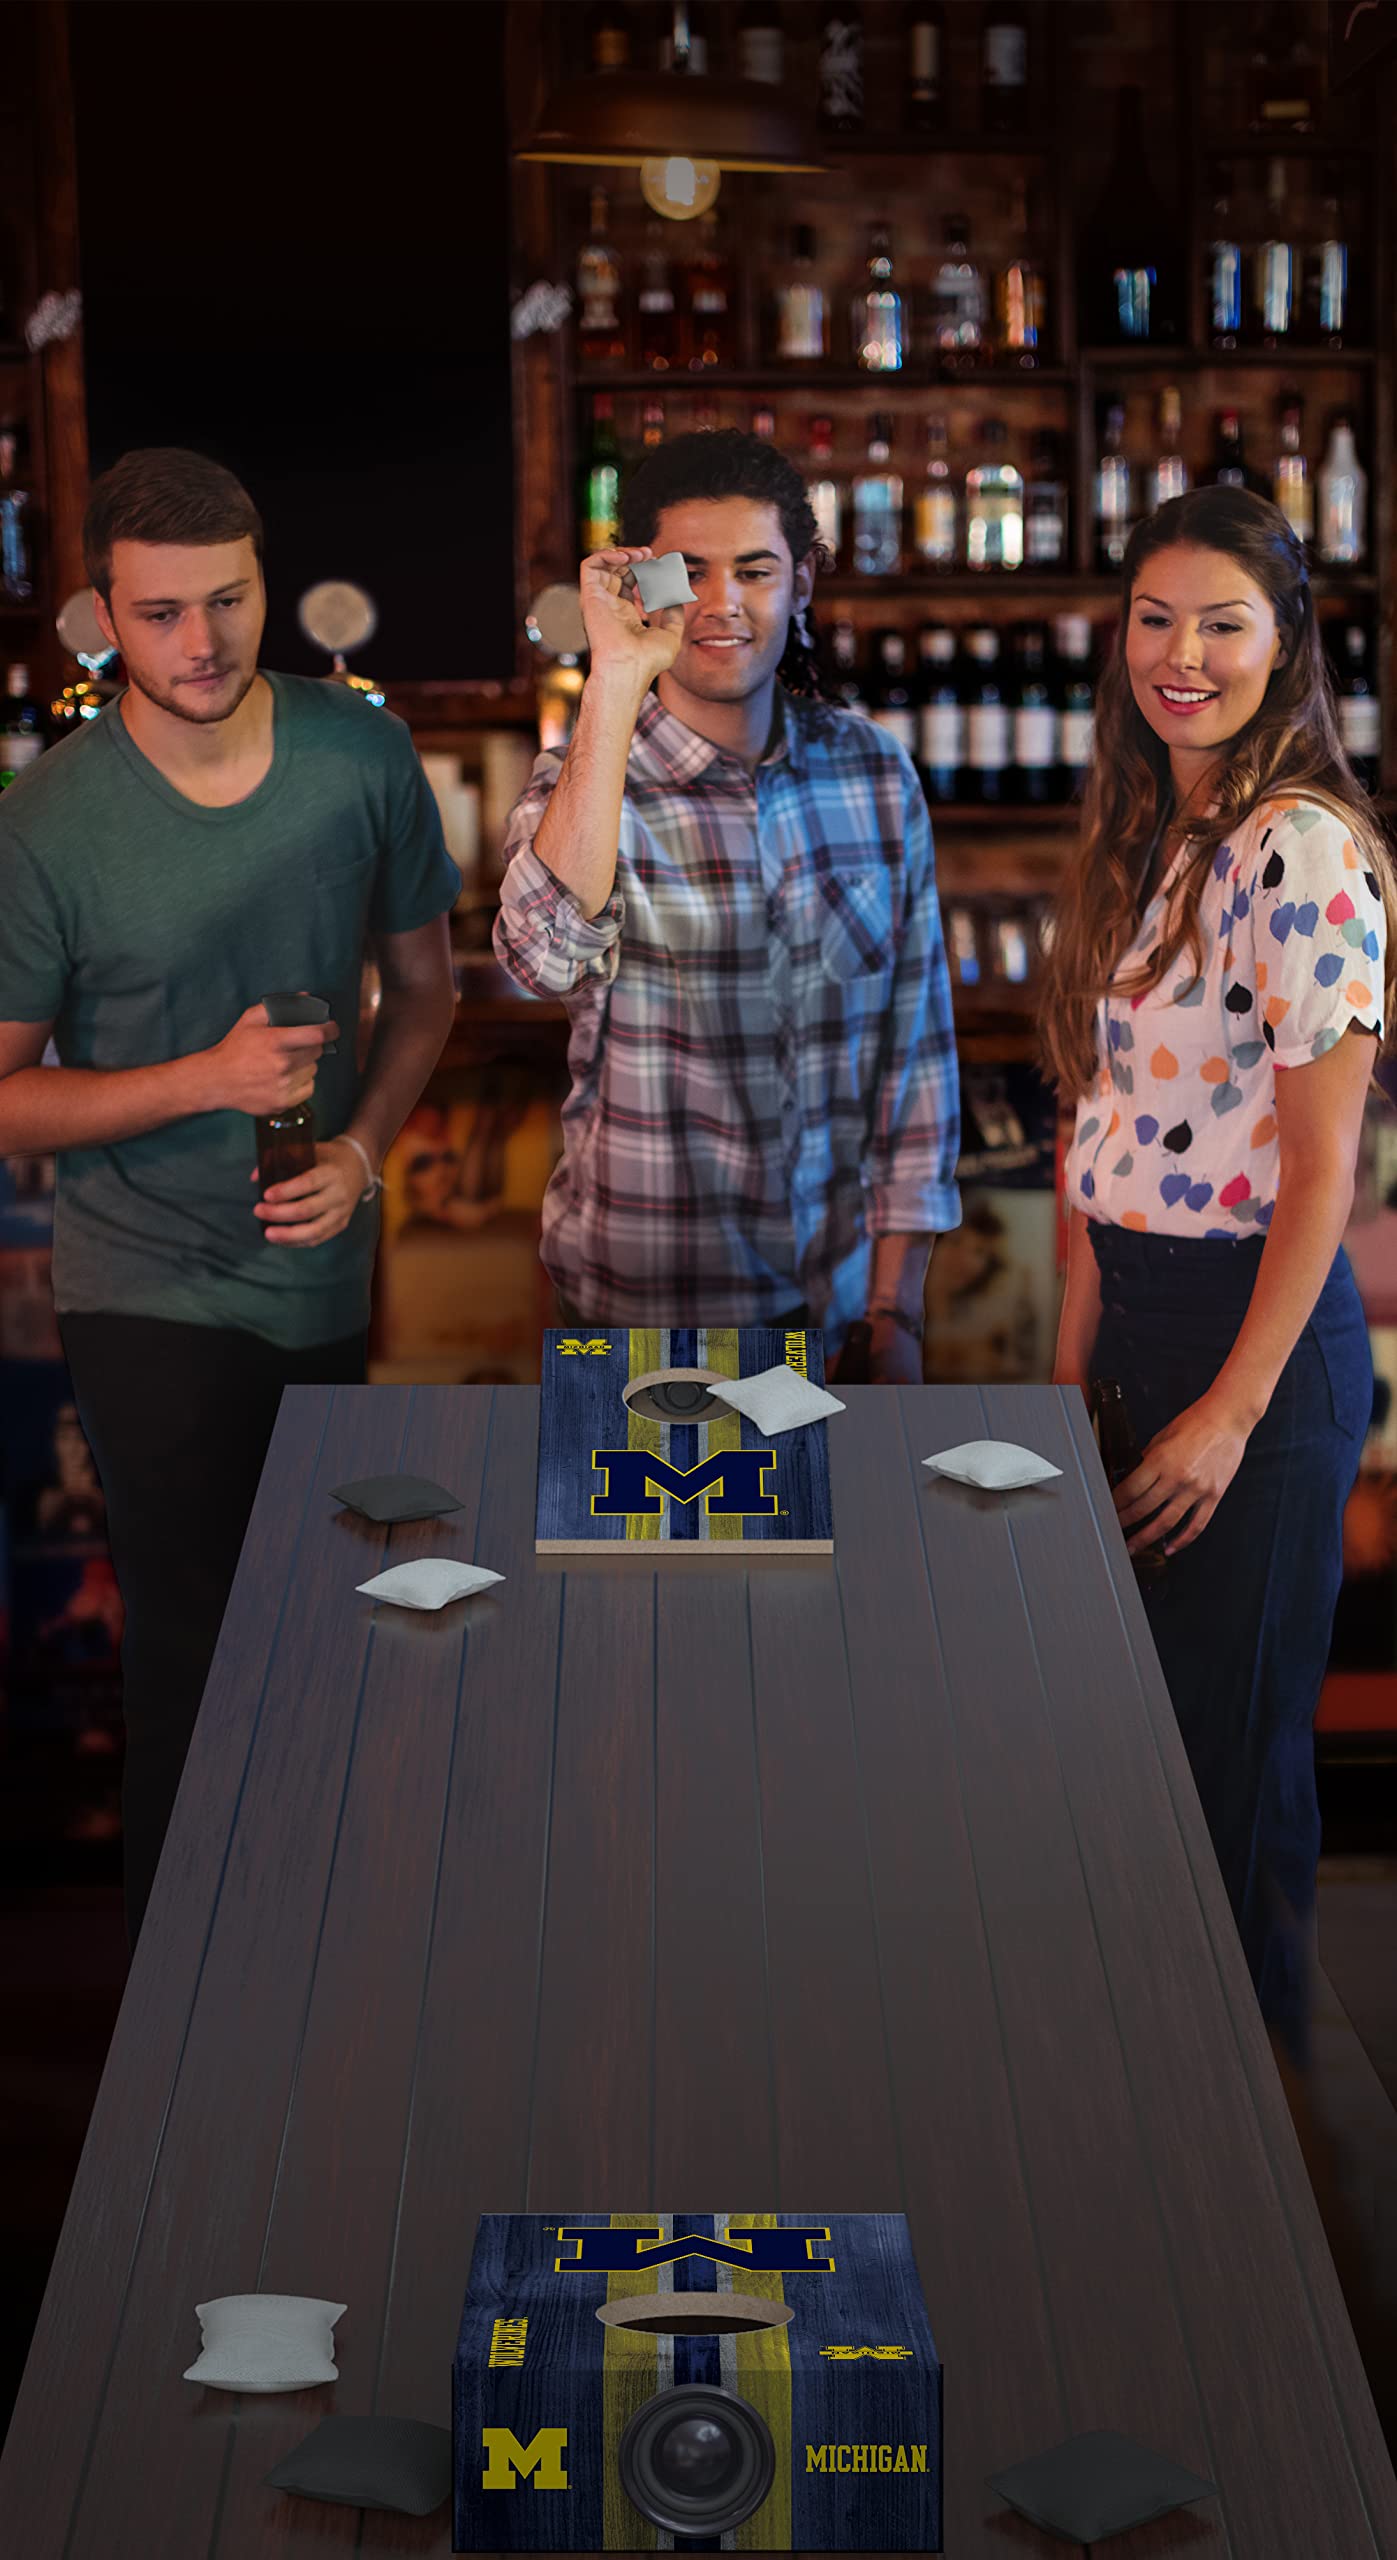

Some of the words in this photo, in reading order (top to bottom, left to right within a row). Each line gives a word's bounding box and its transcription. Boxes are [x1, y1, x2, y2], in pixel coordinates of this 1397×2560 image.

[785, 1331, 807, 1379] WOLVERI
[591, 1450, 778, 1516] M
[554, 2227, 836, 2273] M
[482, 2428, 567, 2489] M
[805, 2445, 928, 2472] MICHIGAN
